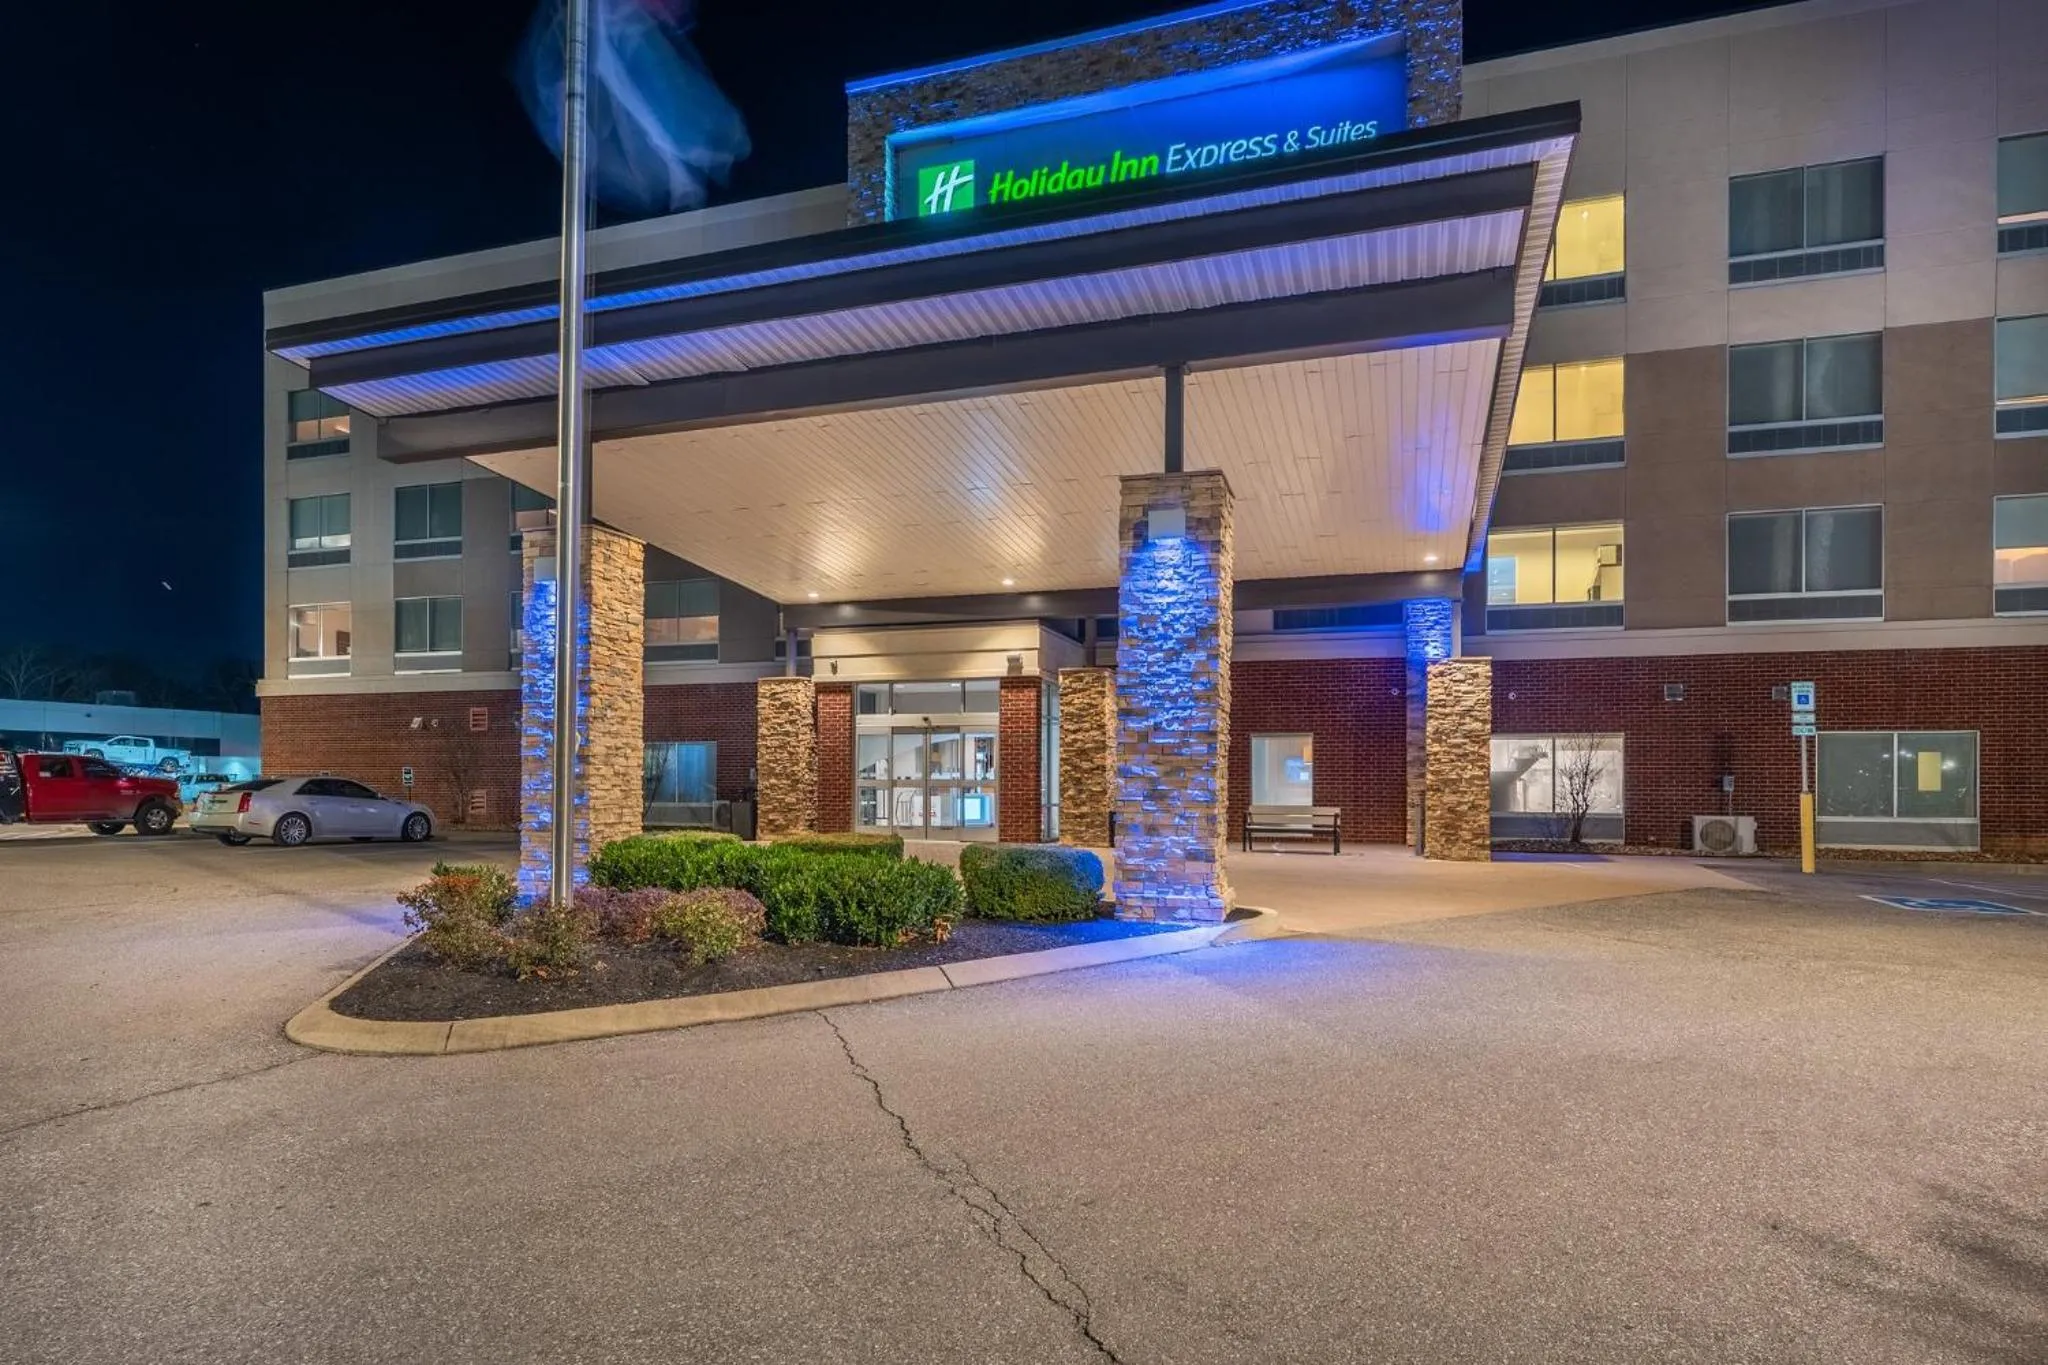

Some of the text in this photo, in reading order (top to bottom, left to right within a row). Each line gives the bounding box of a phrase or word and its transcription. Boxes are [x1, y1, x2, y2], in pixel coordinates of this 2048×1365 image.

[1109, 150, 1160, 184] Inn
[1166, 133, 1279, 173] Express
[1282, 130, 1300, 153] &
[1304, 119, 1379, 150] Suites
